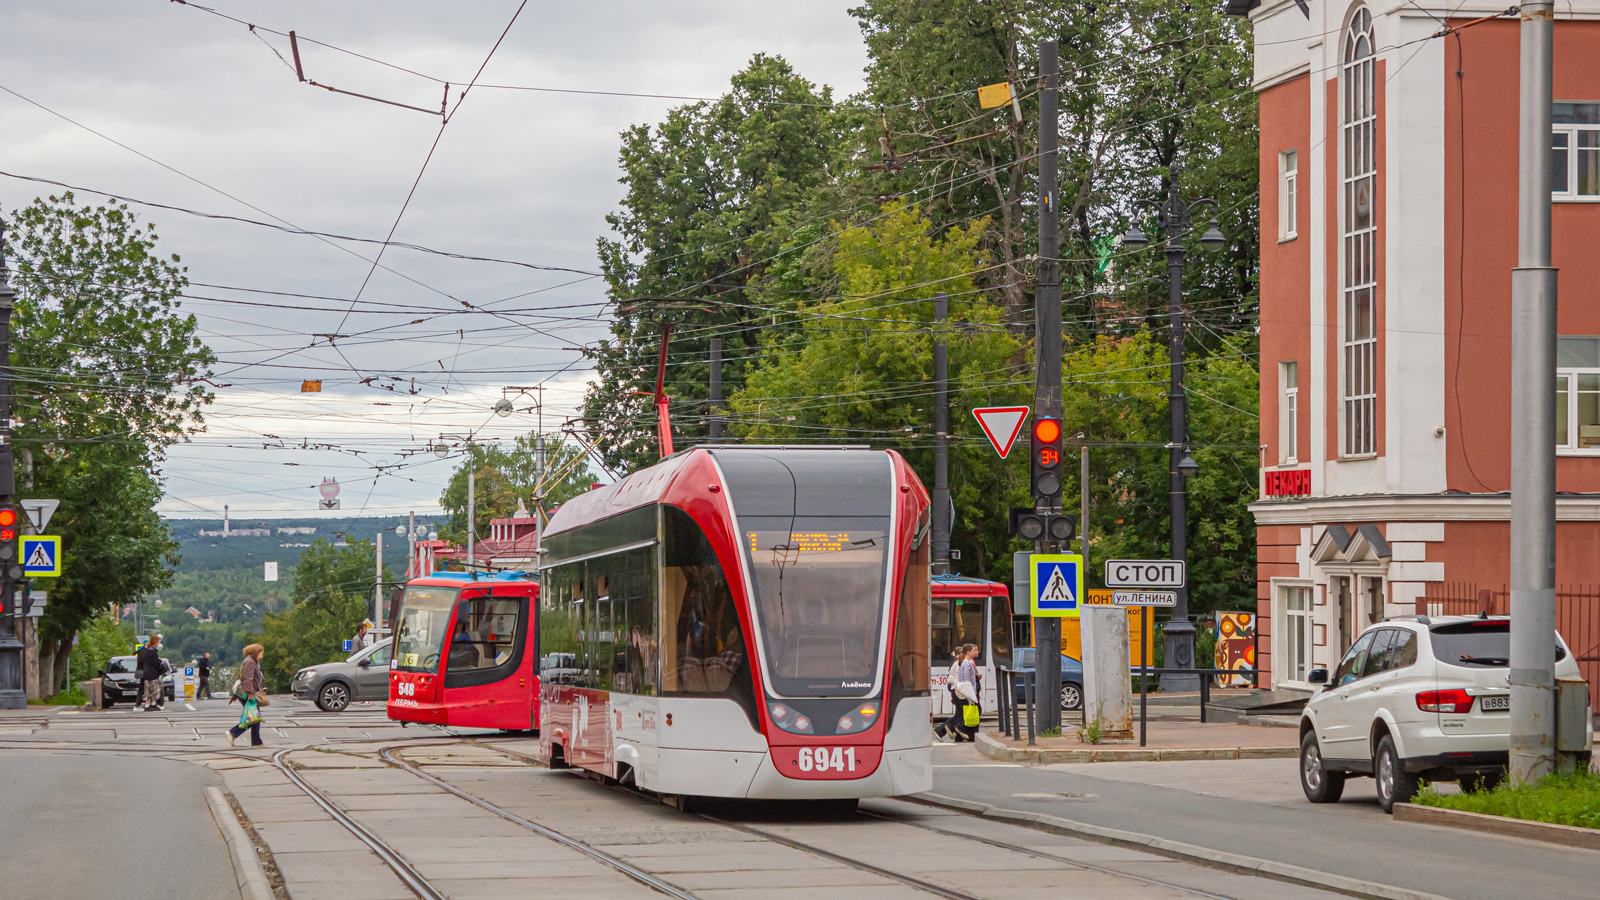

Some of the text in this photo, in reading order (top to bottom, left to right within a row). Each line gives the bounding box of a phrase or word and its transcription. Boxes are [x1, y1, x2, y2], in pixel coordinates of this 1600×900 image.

[1041, 450, 1059, 465] 34
[1, 529, 14, 541] 34
[1116, 565, 1175, 582] СТОП
[398, 682, 415, 696] 548
[841, 681, 872, 689] Львёнок
[394, 698, 419, 707] ПЕРМЬ
[798, 747, 856, 772] 6941
